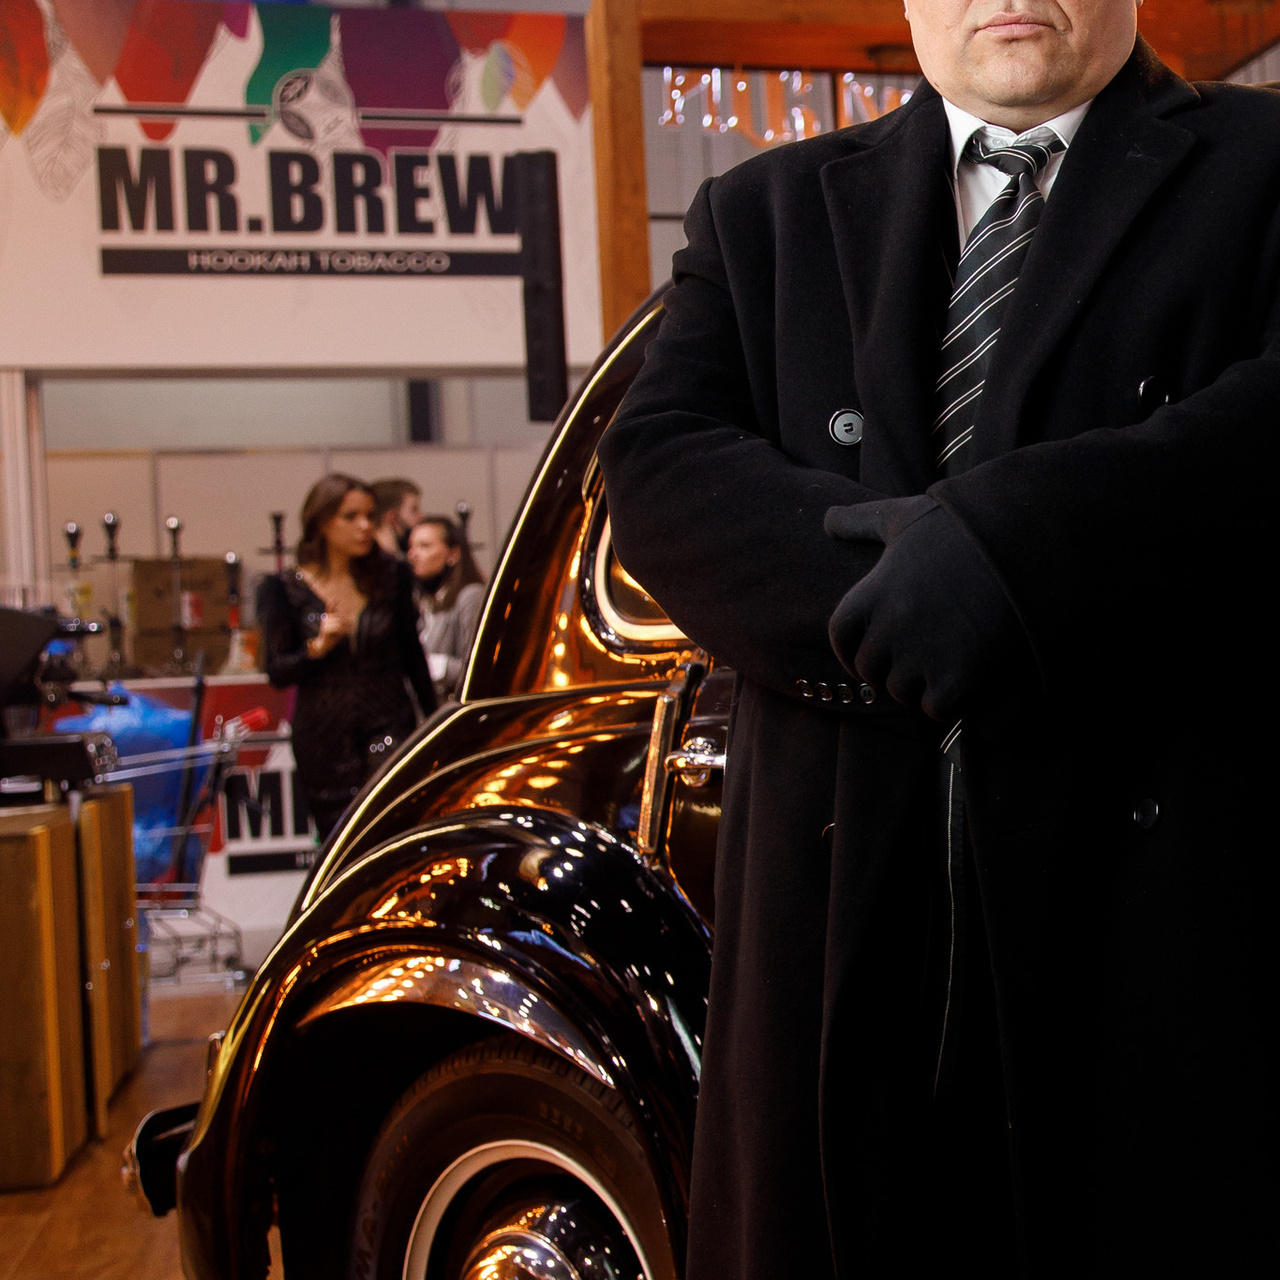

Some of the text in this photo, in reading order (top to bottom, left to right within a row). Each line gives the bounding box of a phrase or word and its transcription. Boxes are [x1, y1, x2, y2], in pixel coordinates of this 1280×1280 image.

[98, 147, 521, 236] MR.BREW
[188, 251, 450, 272] HOOKAH TOBACCO
